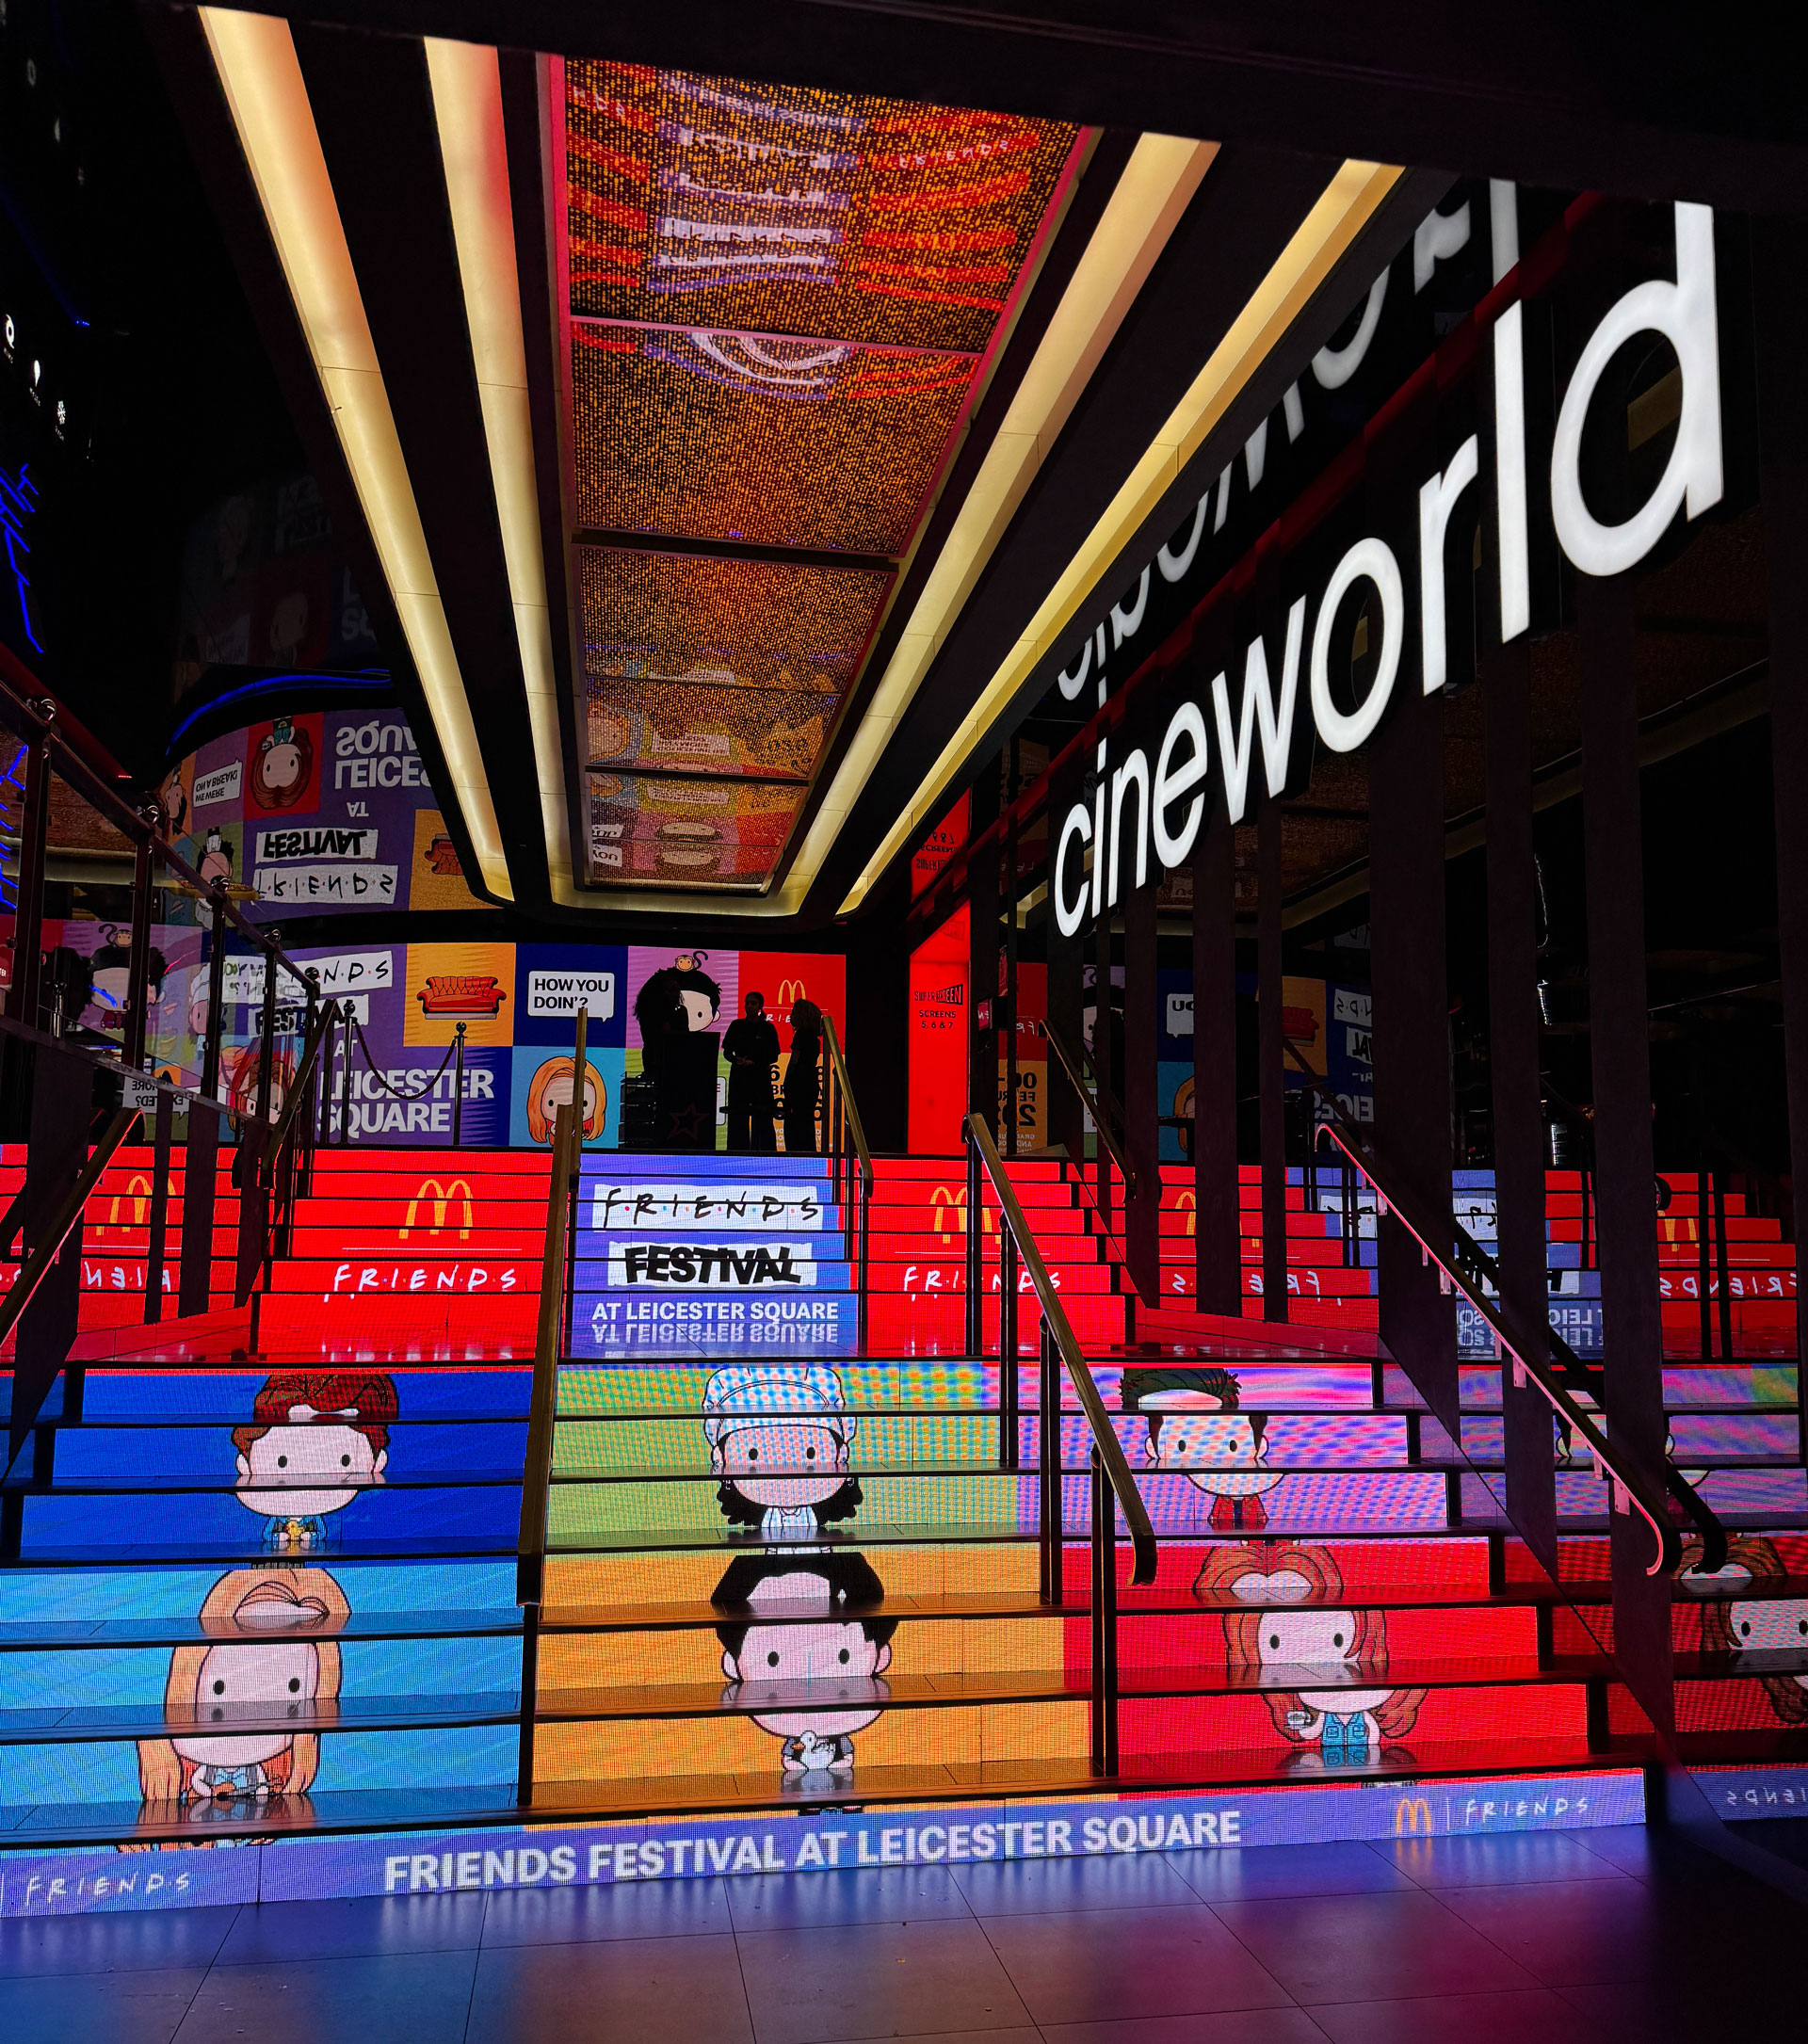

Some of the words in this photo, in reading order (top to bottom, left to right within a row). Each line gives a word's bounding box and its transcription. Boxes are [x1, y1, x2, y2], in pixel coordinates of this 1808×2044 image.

[1055, 201, 1724, 938] cineworld
[533, 978, 573, 993] HOW
[575, 978, 609, 994] YOU
[533, 995, 589, 1009] DOIN'?
[919, 1009, 957, 1019] SCREENS
[931, 1021, 937, 1029] 6
[939, 1021, 945, 1029] &
[948, 1021, 954, 1029] 7
[320, 1069, 494, 1101] LEICESTER
[316, 1102, 450, 1138] SQUARE
[605, 1188, 821, 1229] FRIENDS
[330, 1262, 516, 1293] FRIENDS
[625, 1246, 801, 1284] FESTIVAL
[592, 1303, 619, 1320] AT
[626, 1303, 746, 1320] LEICESTER
[750, 1302, 838, 1323] SQUARE
[1464, 1796, 1590, 1827] FRIENDS
[385, 1845, 576, 1892] FRIENDS
[589, 1833, 784, 1879] FESTIVAL
[797, 1830, 848, 1867] AT
[857, 1818, 1074, 1866] LEICESTER
[1082, 1810, 1242, 1853] SQUARE
[25, 1872, 191, 1907] FRIENDS
